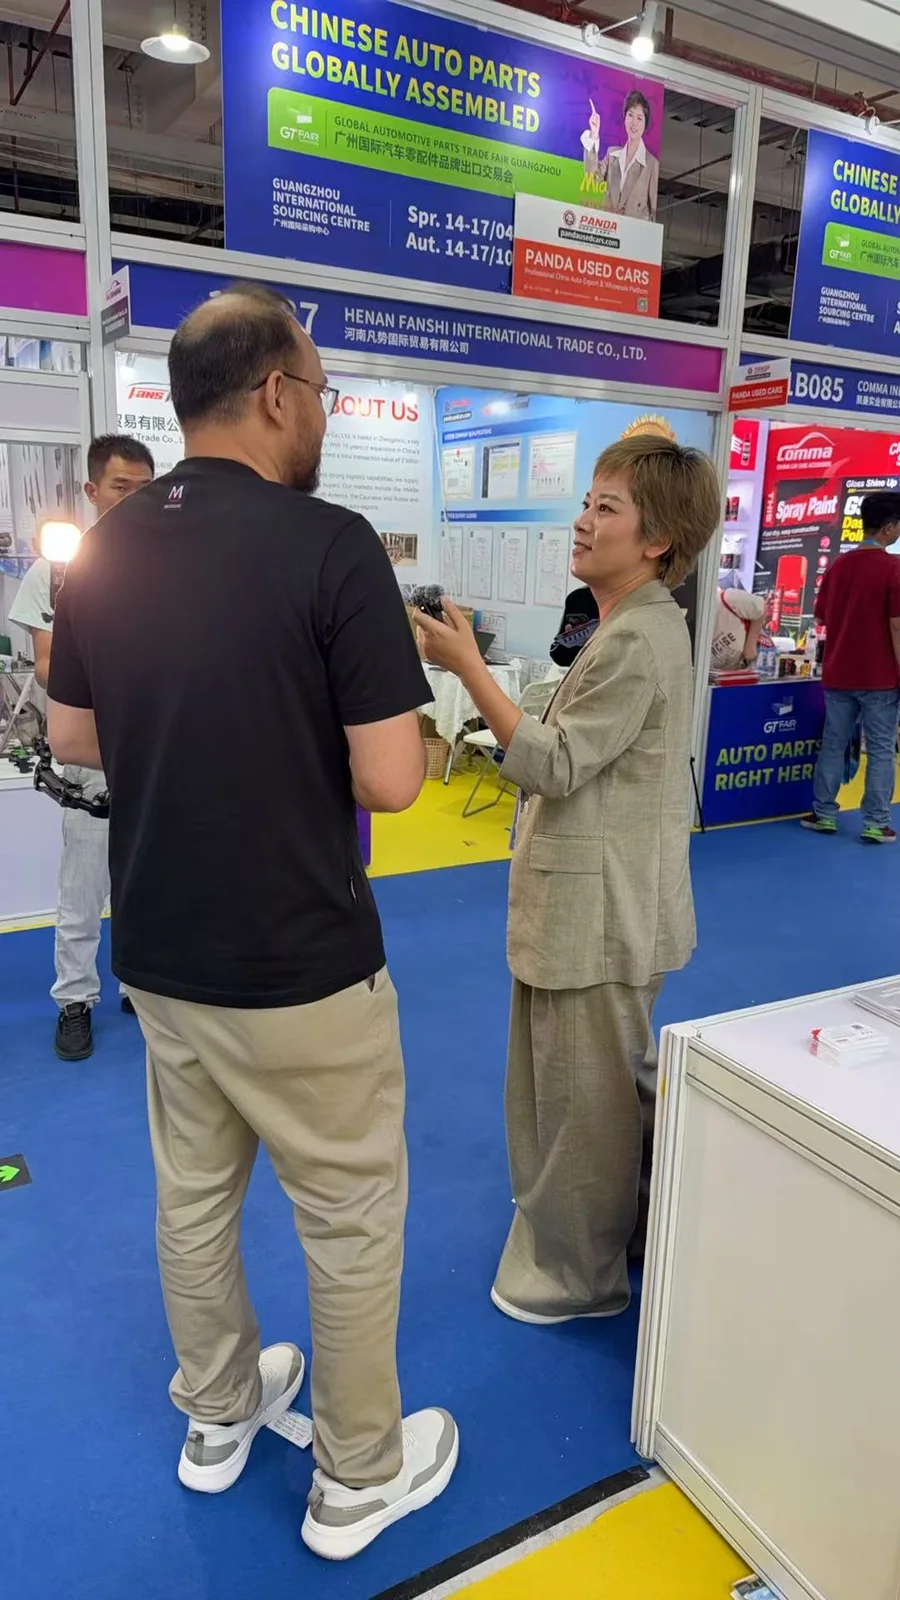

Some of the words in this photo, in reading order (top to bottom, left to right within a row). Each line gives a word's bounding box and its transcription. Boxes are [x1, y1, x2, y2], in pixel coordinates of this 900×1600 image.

[270, 0, 388, 57] CHINESE
[394, 35, 462, 76] AUTO
[469, 55, 540, 98] PARTS
[271, 42, 401, 98] GLOBALLY
[405, 77, 540, 133] ASSEMBLED
[280, 126, 298, 140] GT
[334, 116, 371, 133] GLOBAL
[373, 125, 430, 147] AUTOMOTIVE
[433, 140, 461, 154] PARTS
[462, 146, 489, 160] TRADE
[491, 152, 510, 165] FAIR
[510, 157, 562, 177] GUANGZHOU
[334, 131, 514, 184] 广州国际汽车零配件品牌出口交易会
[272, 177, 340, 201] GUANGZHOU
[580, 171, 608, 193] Mia
[833, 159, 898, 195] CHINESE
[272, 190, 356, 217] INTERNATIONAL
[272, 204, 329, 224] SOURCING
[330, 215, 371, 232] CENTRE
[408, 205, 440, 229] Spr.
[445, 213, 513, 242] 14-17/04
[580, 215, 618, 231] PANDA
[406, 232, 440, 254] Aut.
[445, 239, 513, 267] 14-17/10
[525, 249, 574, 272] PANDA
[577, 259, 612, 279] USED
[615, 266, 650, 285] CARS
[820, 296, 867, 312] INTERNATIONAL
[821, 286, 860, 301] GUANGZHOU
[819, 305, 850, 319] SOURCING
[851, 311, 875, 323] CENTRE
[344, 307, 395, 328] HENAN
[399, 314, 449, 336] FANSHI
[452, 321, 553, 349] INTERNATIONAL
[556, 336, 595, 354] TRADE
[597, 342, 620, 361] CO.,
[622, 346, 647, 361] LTD.
[344, 326, 469, 355] 河南凡势国际贸易有限公司
[857, 380, 889, 395] COMMA
[391, 399, 419, 422] US
[777, 445, 833, 462] Comma
[845, 480, 865, 488] Gloss
[865, 479, 886, 488] Shine
[886, 478, 898, 488] Up
[776, 500, 805, 523] Spray
[807, 495, 838, 518] Paint
[842, 516, 863, 529] Das
[841, 529, 864, 542] Poli
[763, 721, 779, 733] GT
[778, 719, 797, 729] FAIR
[715, 744, 767, 767] AUTO
[715, 767, 774, 792] RIGHT
[777, 763, 815, 784] HER
